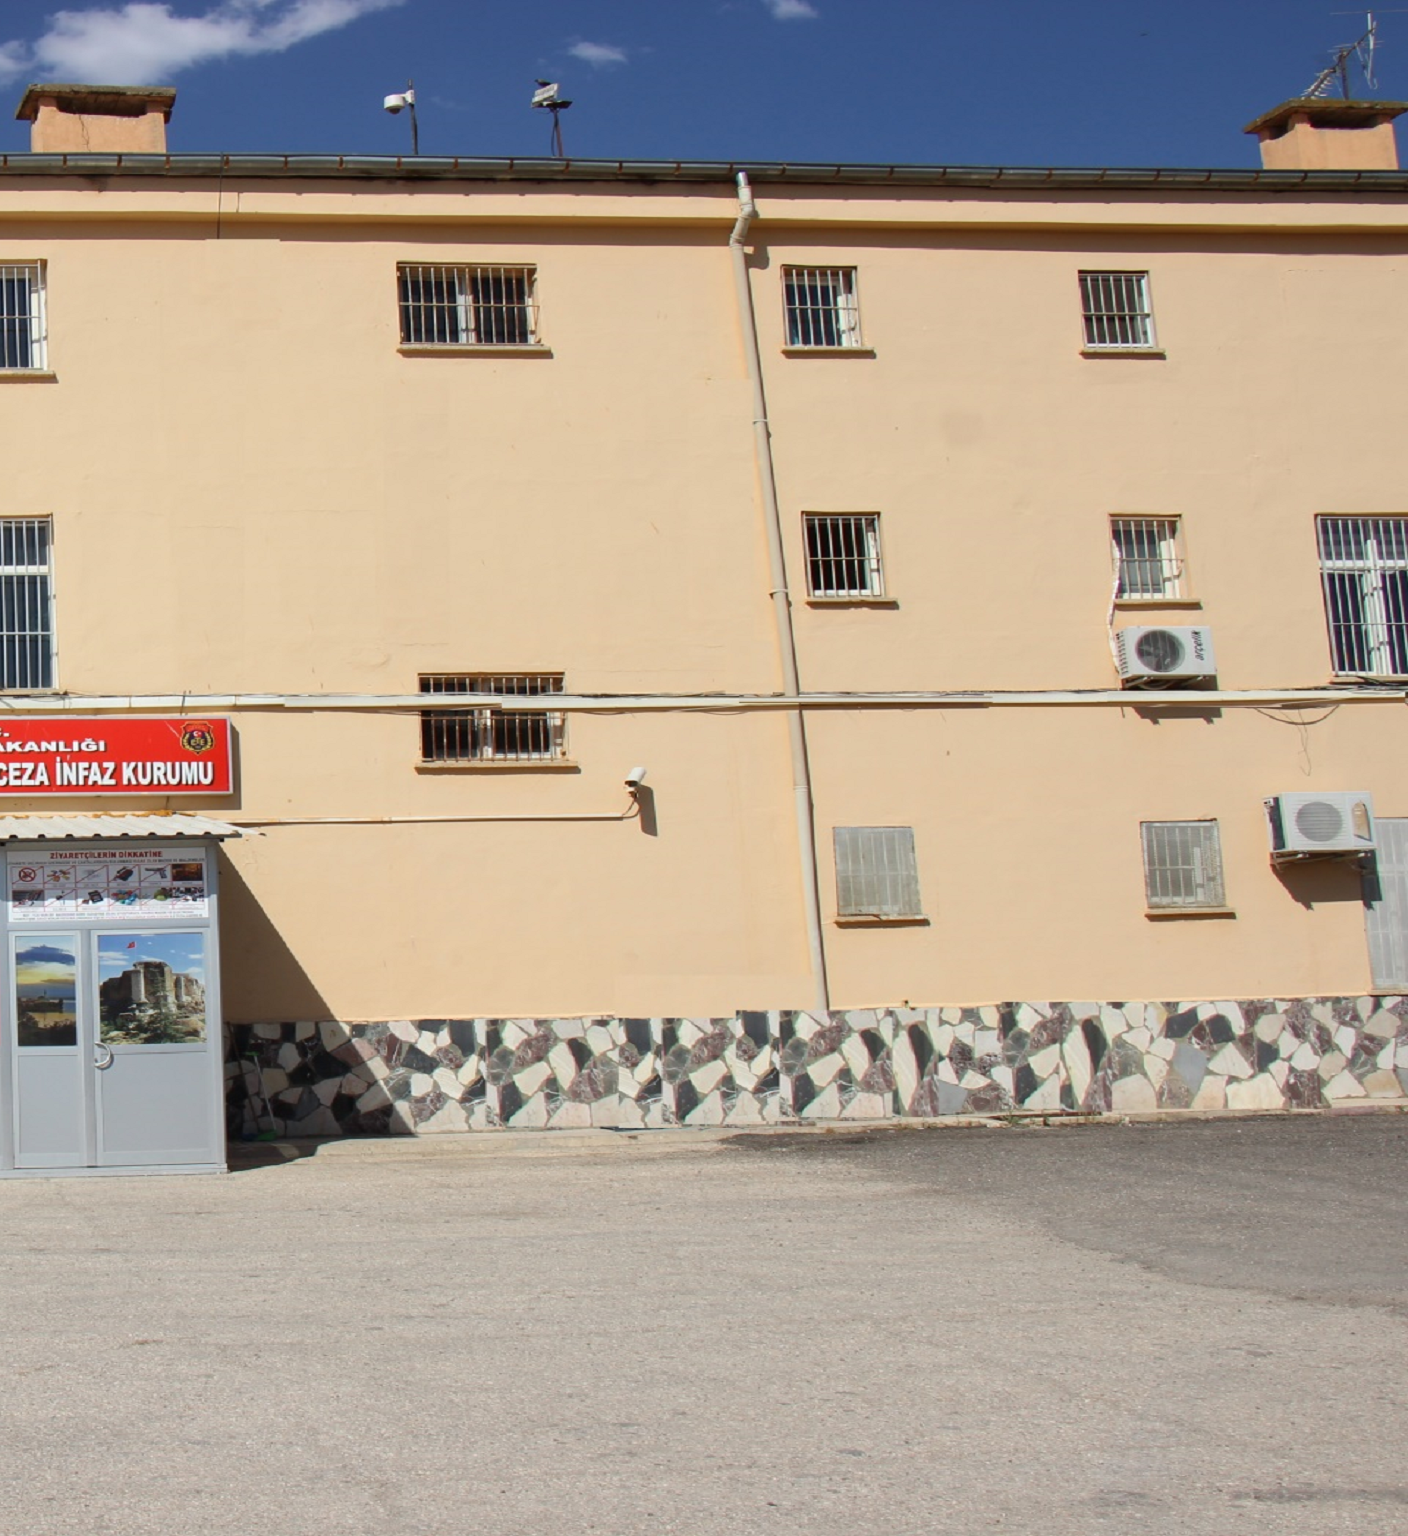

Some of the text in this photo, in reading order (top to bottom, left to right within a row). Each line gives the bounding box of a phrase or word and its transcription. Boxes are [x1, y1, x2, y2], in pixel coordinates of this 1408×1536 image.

[55, 756, 117, 786] İNFAZ
[121, 761, 214, 786] KURUMU
[118, 850, 164, 858] DİKKATİNE
